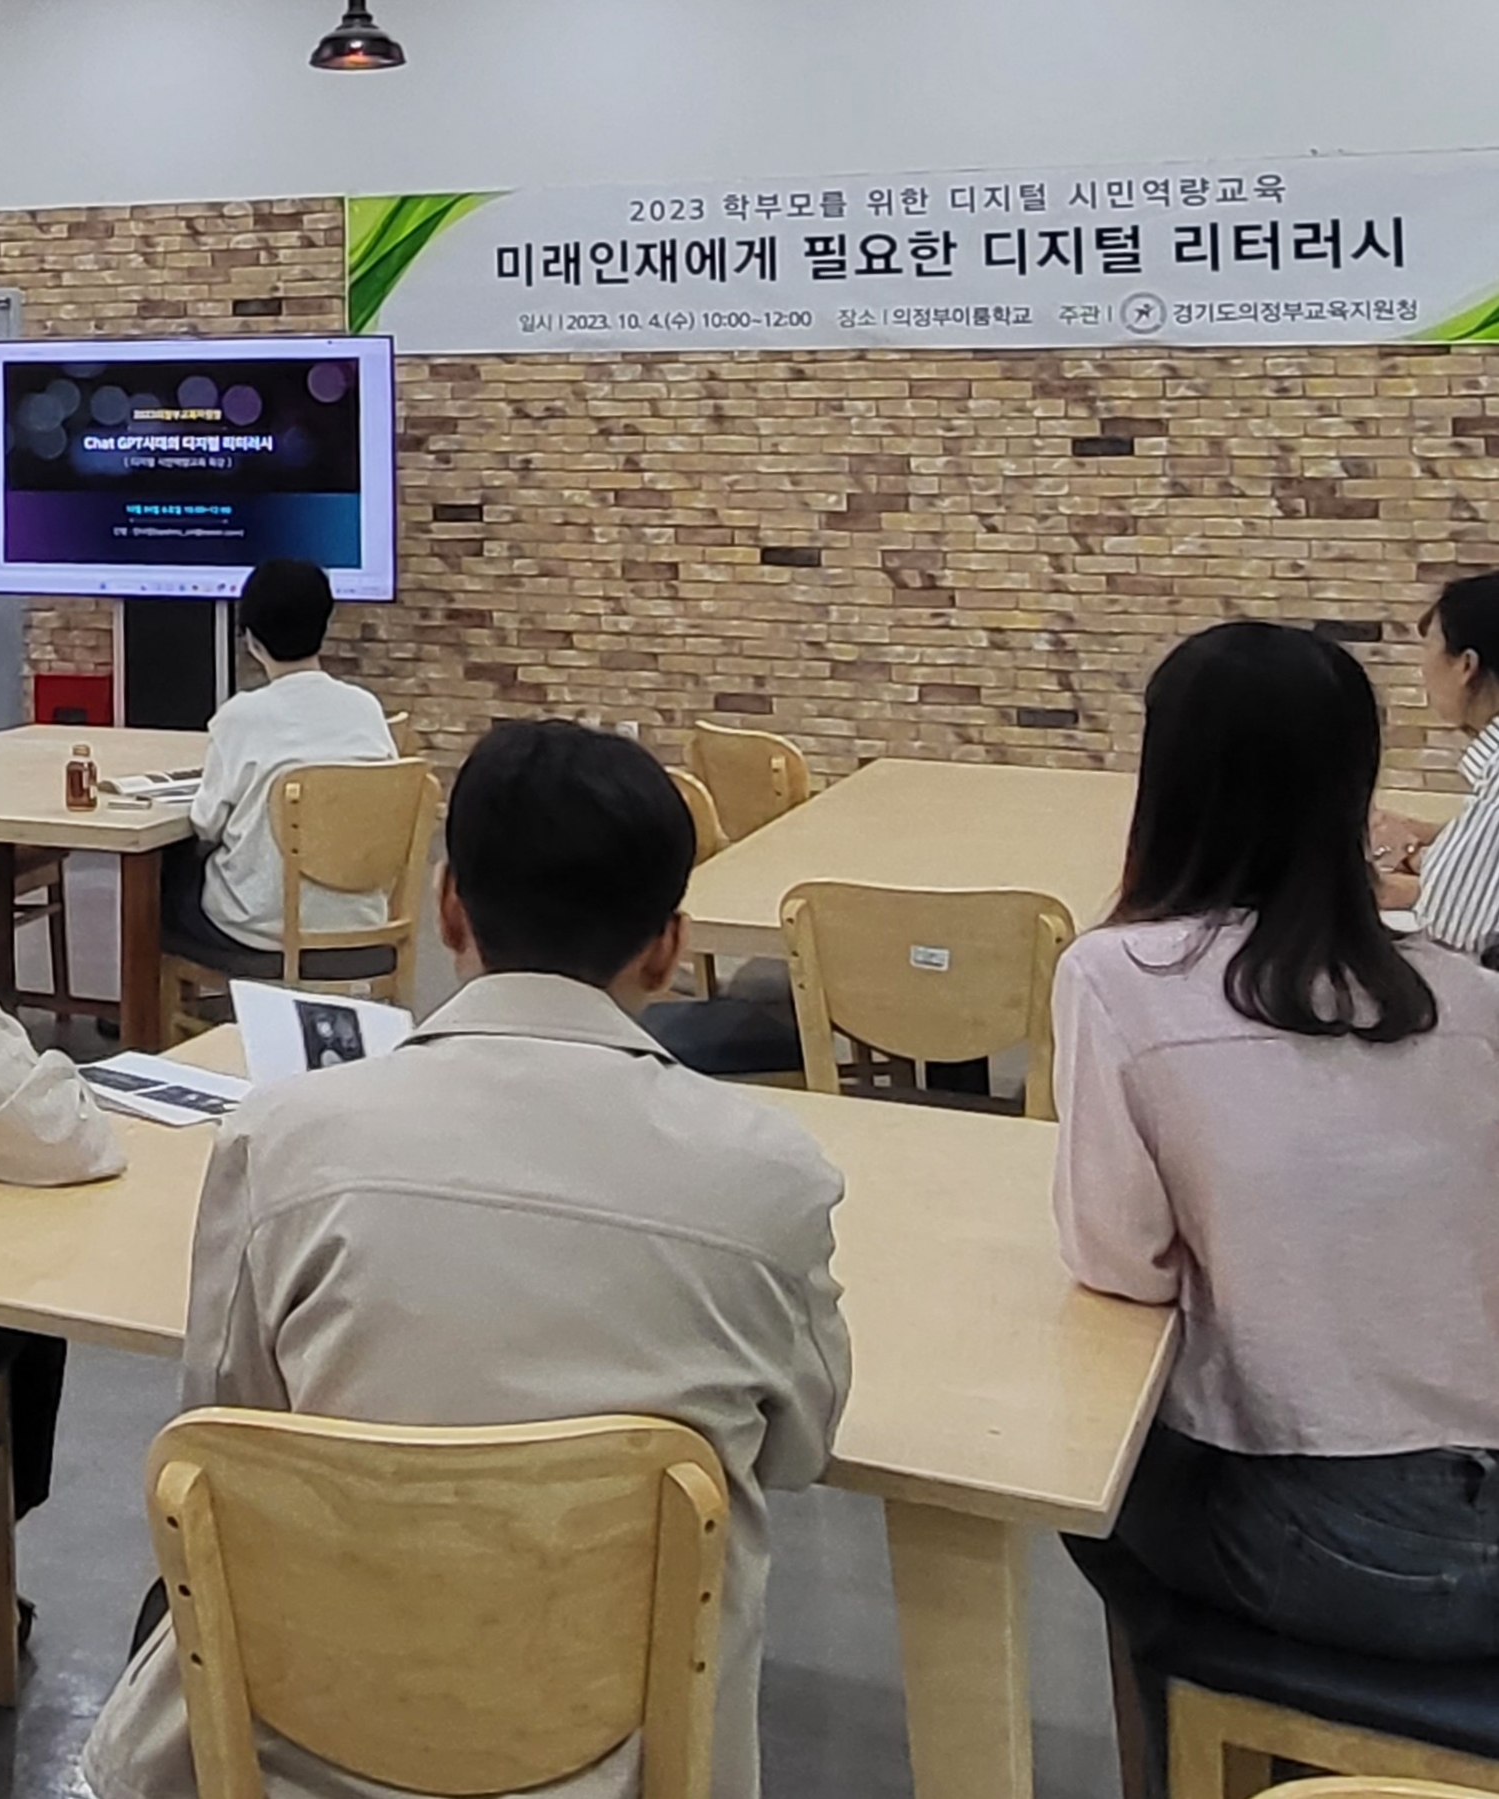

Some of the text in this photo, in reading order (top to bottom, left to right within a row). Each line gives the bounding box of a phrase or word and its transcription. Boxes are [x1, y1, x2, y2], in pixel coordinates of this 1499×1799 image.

[630, 174, 1287, 222] 2023 학부모를 위한 디지털 시민역량교육
[496, 216, 1405, 288] 미래인재에게 필요한 디지털 리터러시
[519, 314, 552, 333] 일시
[703, 310, 813, 329] 10:00~12:00
[838, 309, 877, 329] 장소
[893, 306, 1034, 328] 의정부이룸학교
[1059, 305, 1101, 326] 주관
[1172, 298, 1418, 326] 경기도의정부교육지원청
[83, 435, 116, 450] Chat
[182, 435, 220, 452] 디지털
